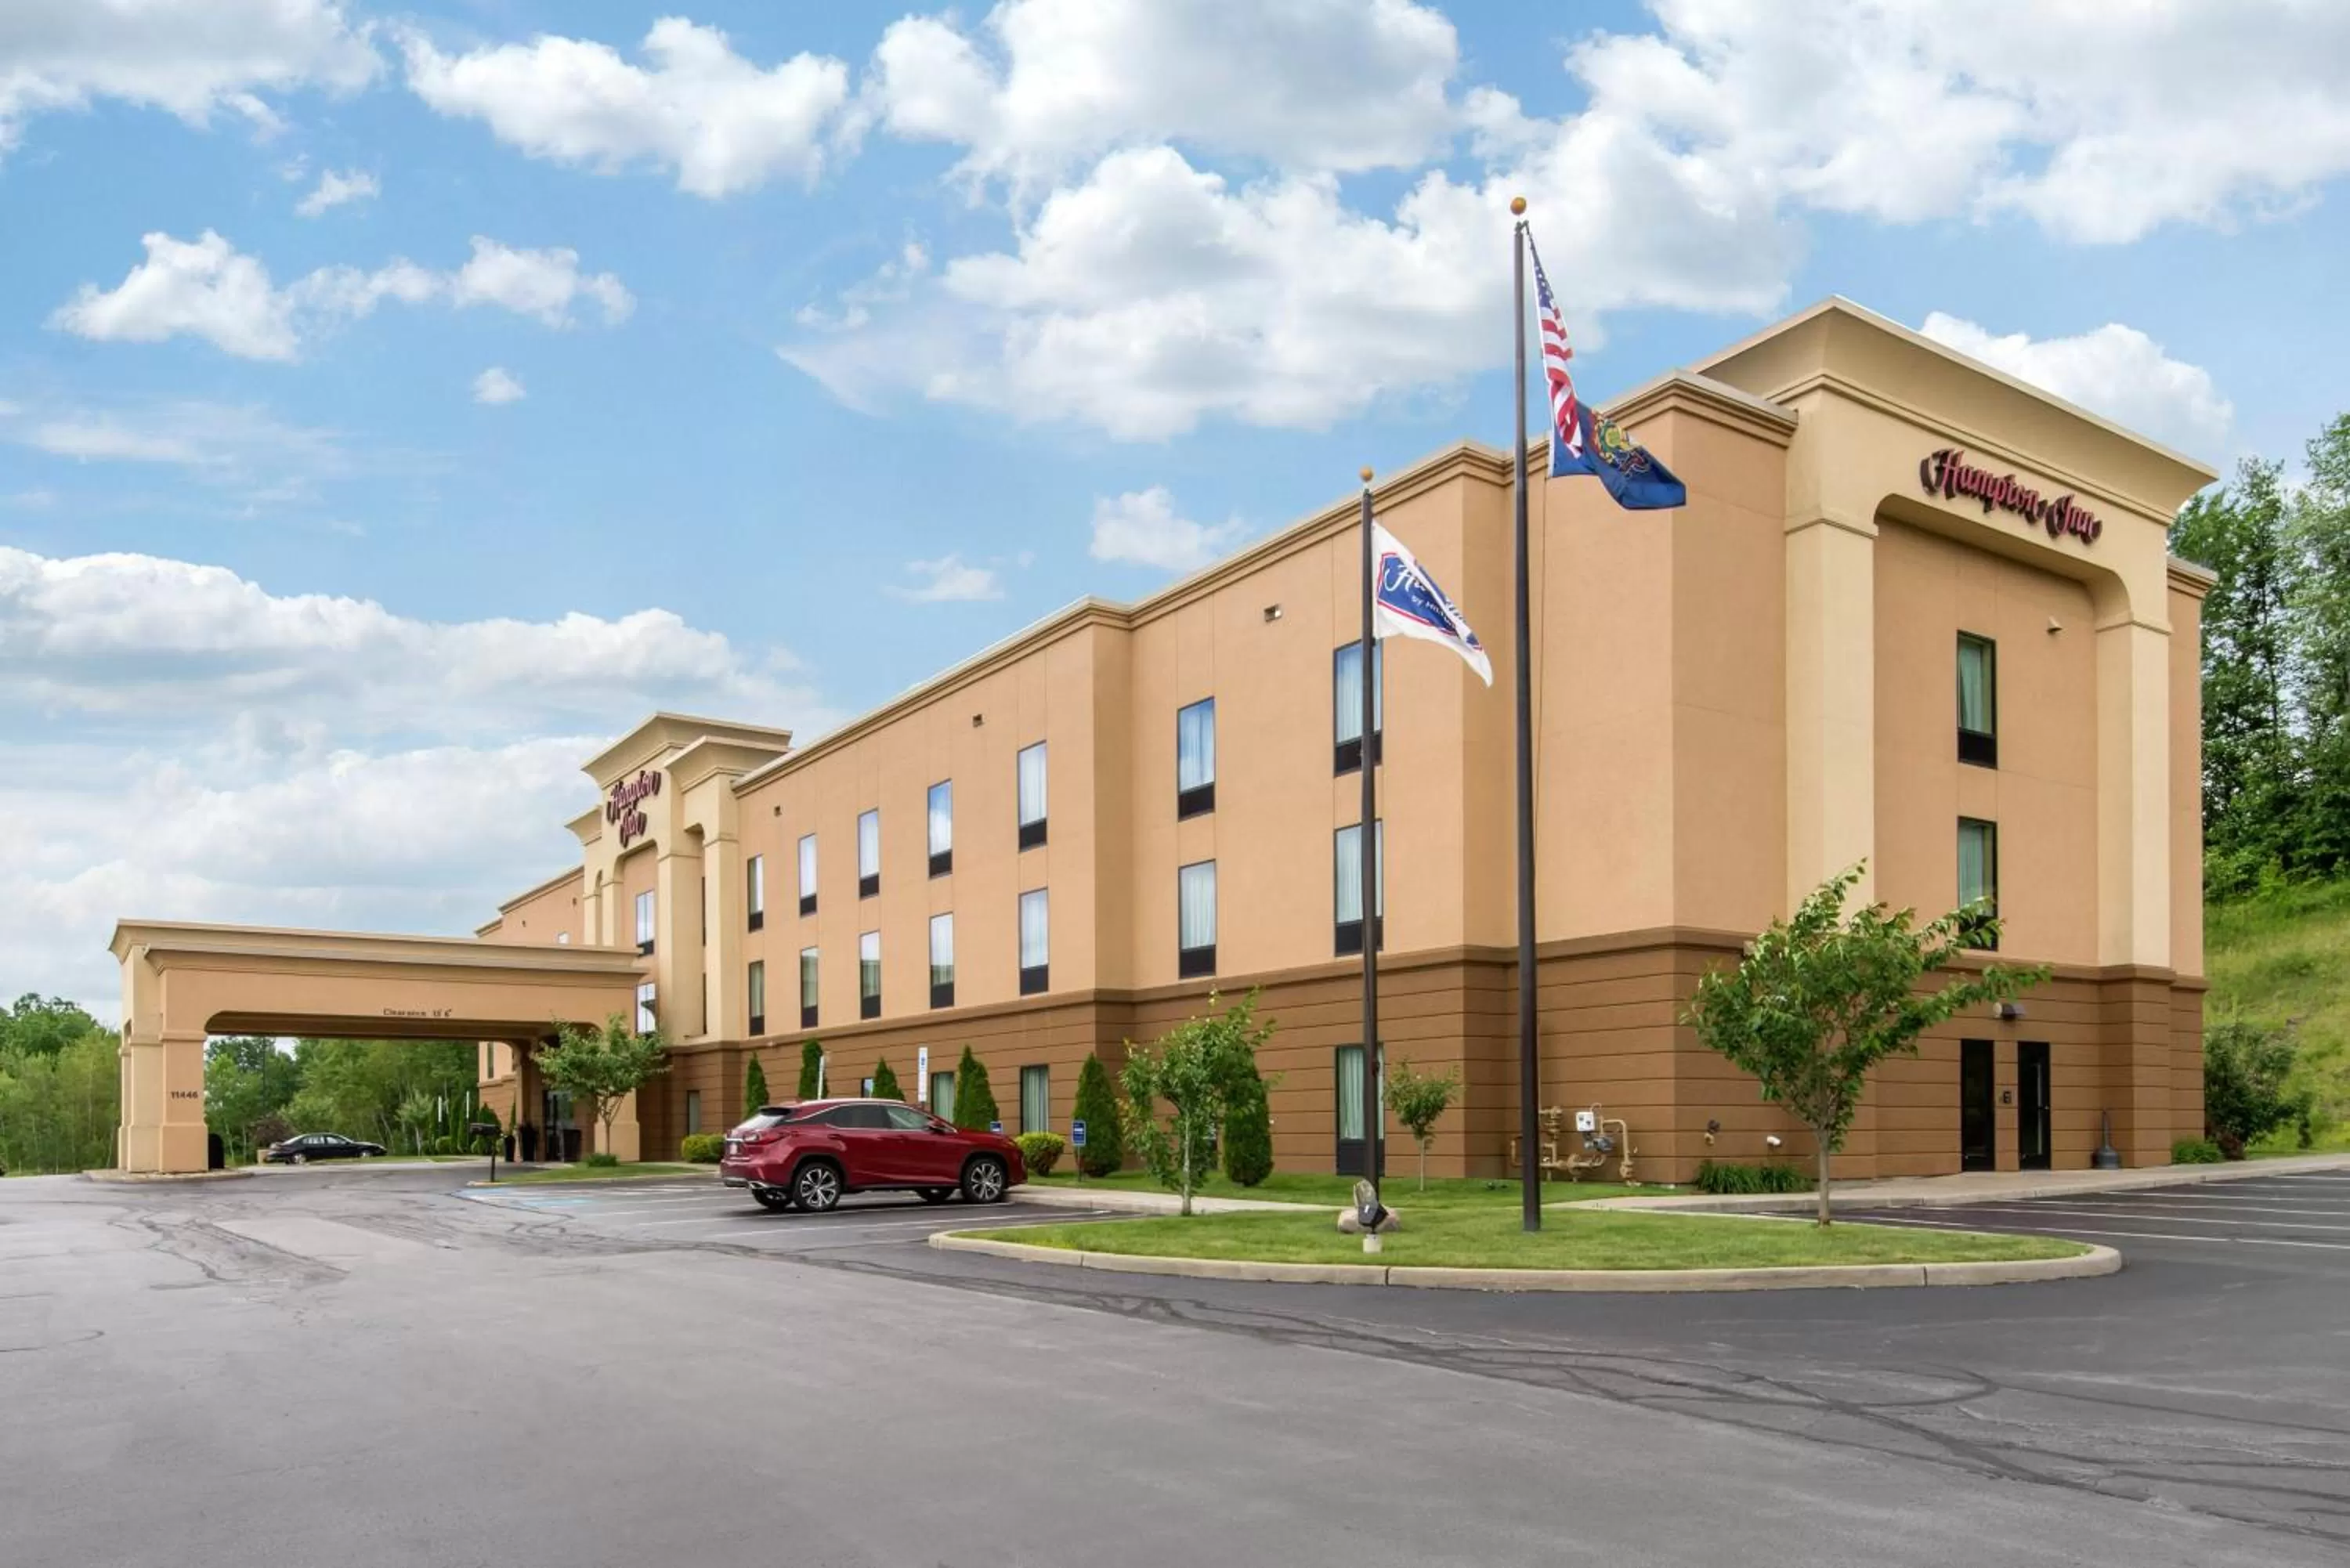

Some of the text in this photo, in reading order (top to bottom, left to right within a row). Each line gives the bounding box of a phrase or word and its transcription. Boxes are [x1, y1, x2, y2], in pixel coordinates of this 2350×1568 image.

[1920, 448, 2103, 545] Hampton Inn
[606, 770, 662, 826] Hampton
[620, 808, 648, 848] Inn
